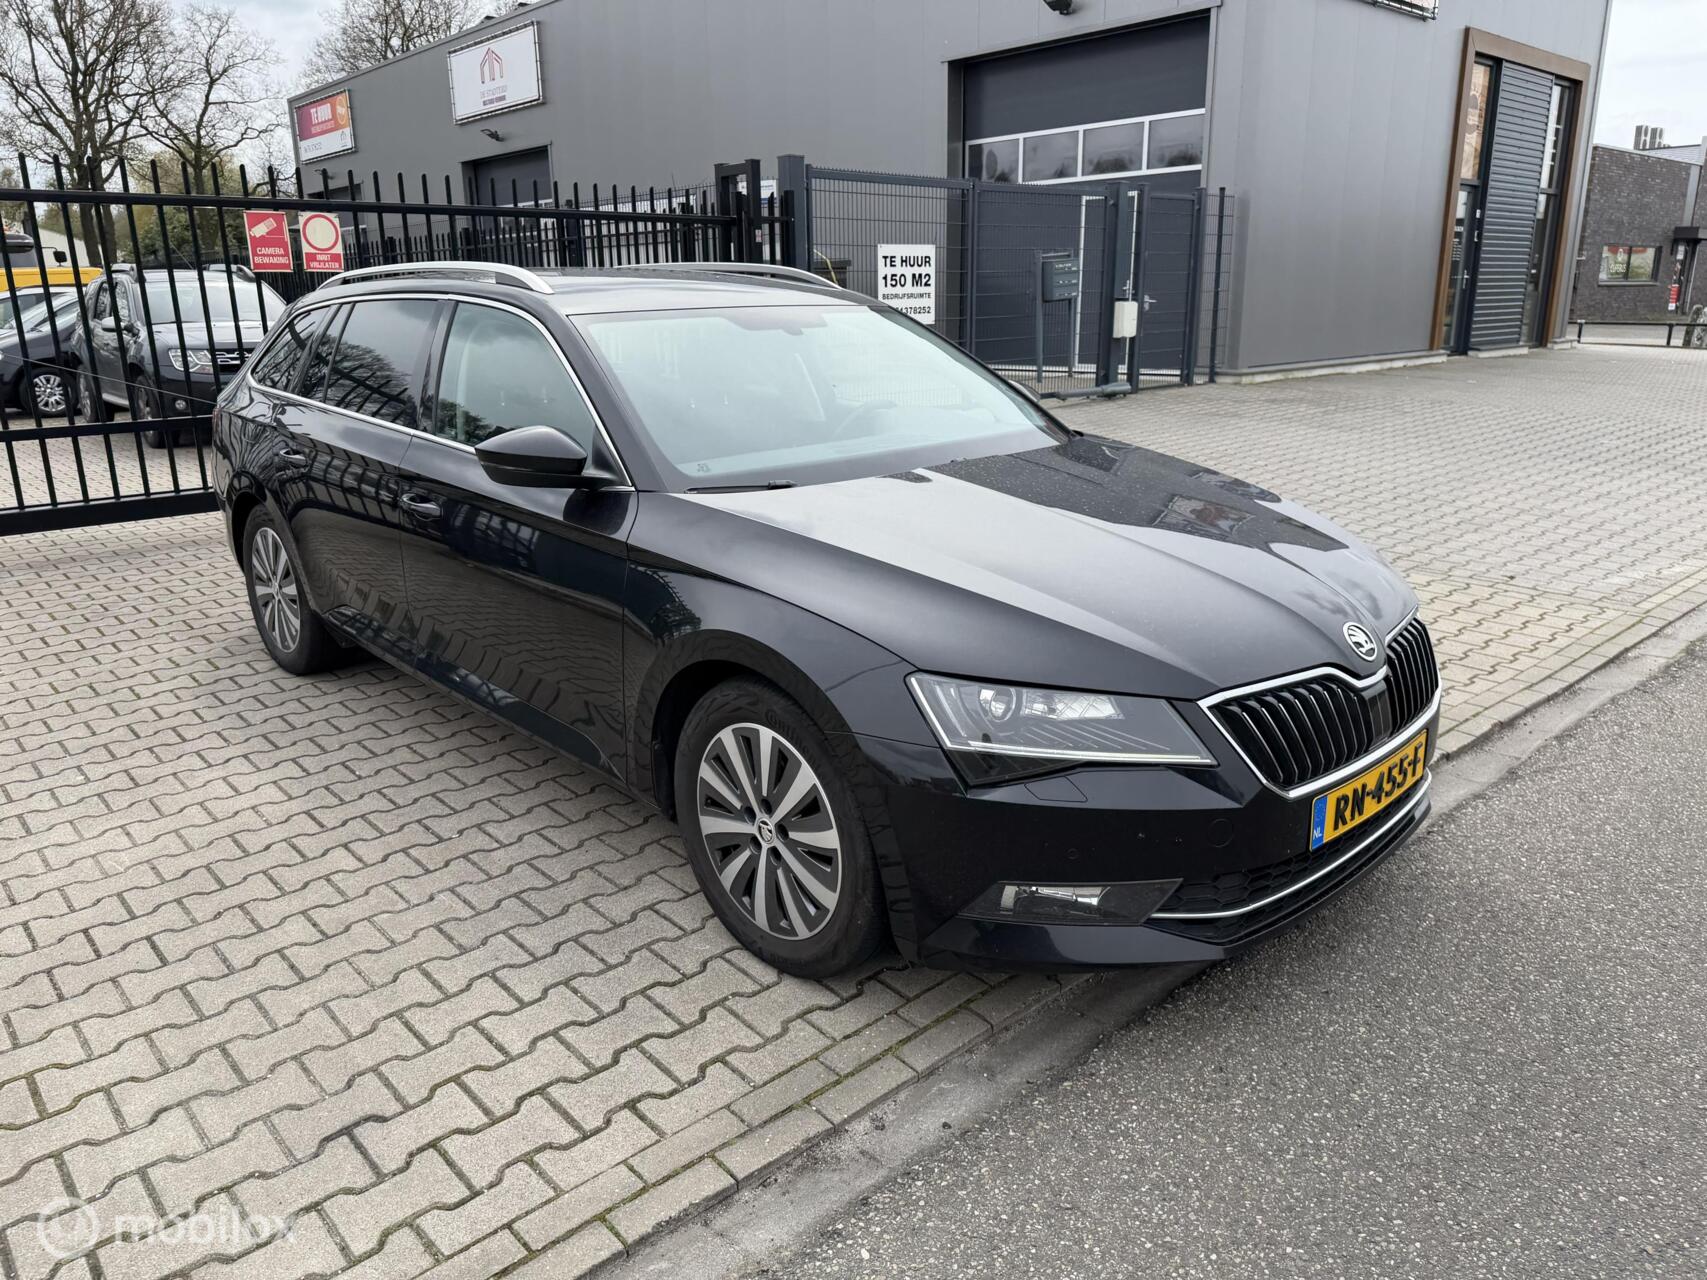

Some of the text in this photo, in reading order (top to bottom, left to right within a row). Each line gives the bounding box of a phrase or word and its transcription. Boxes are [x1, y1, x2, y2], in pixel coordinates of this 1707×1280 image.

[256, 247, 285, 255] CAMERA
[254, 256, 289, 264] BEWAKING
[310, 261, 340, 269] VRIJLATEN
[882, 255, 932, 267] TE HUUR
[882, 273, 931, 288] 150 M2
[882, 292, 932, 300] BEDRIJFSRUIMTE
[1334, 742, 1423, 831] RN-455-F
[1312, 826, 1322, 840] NL
